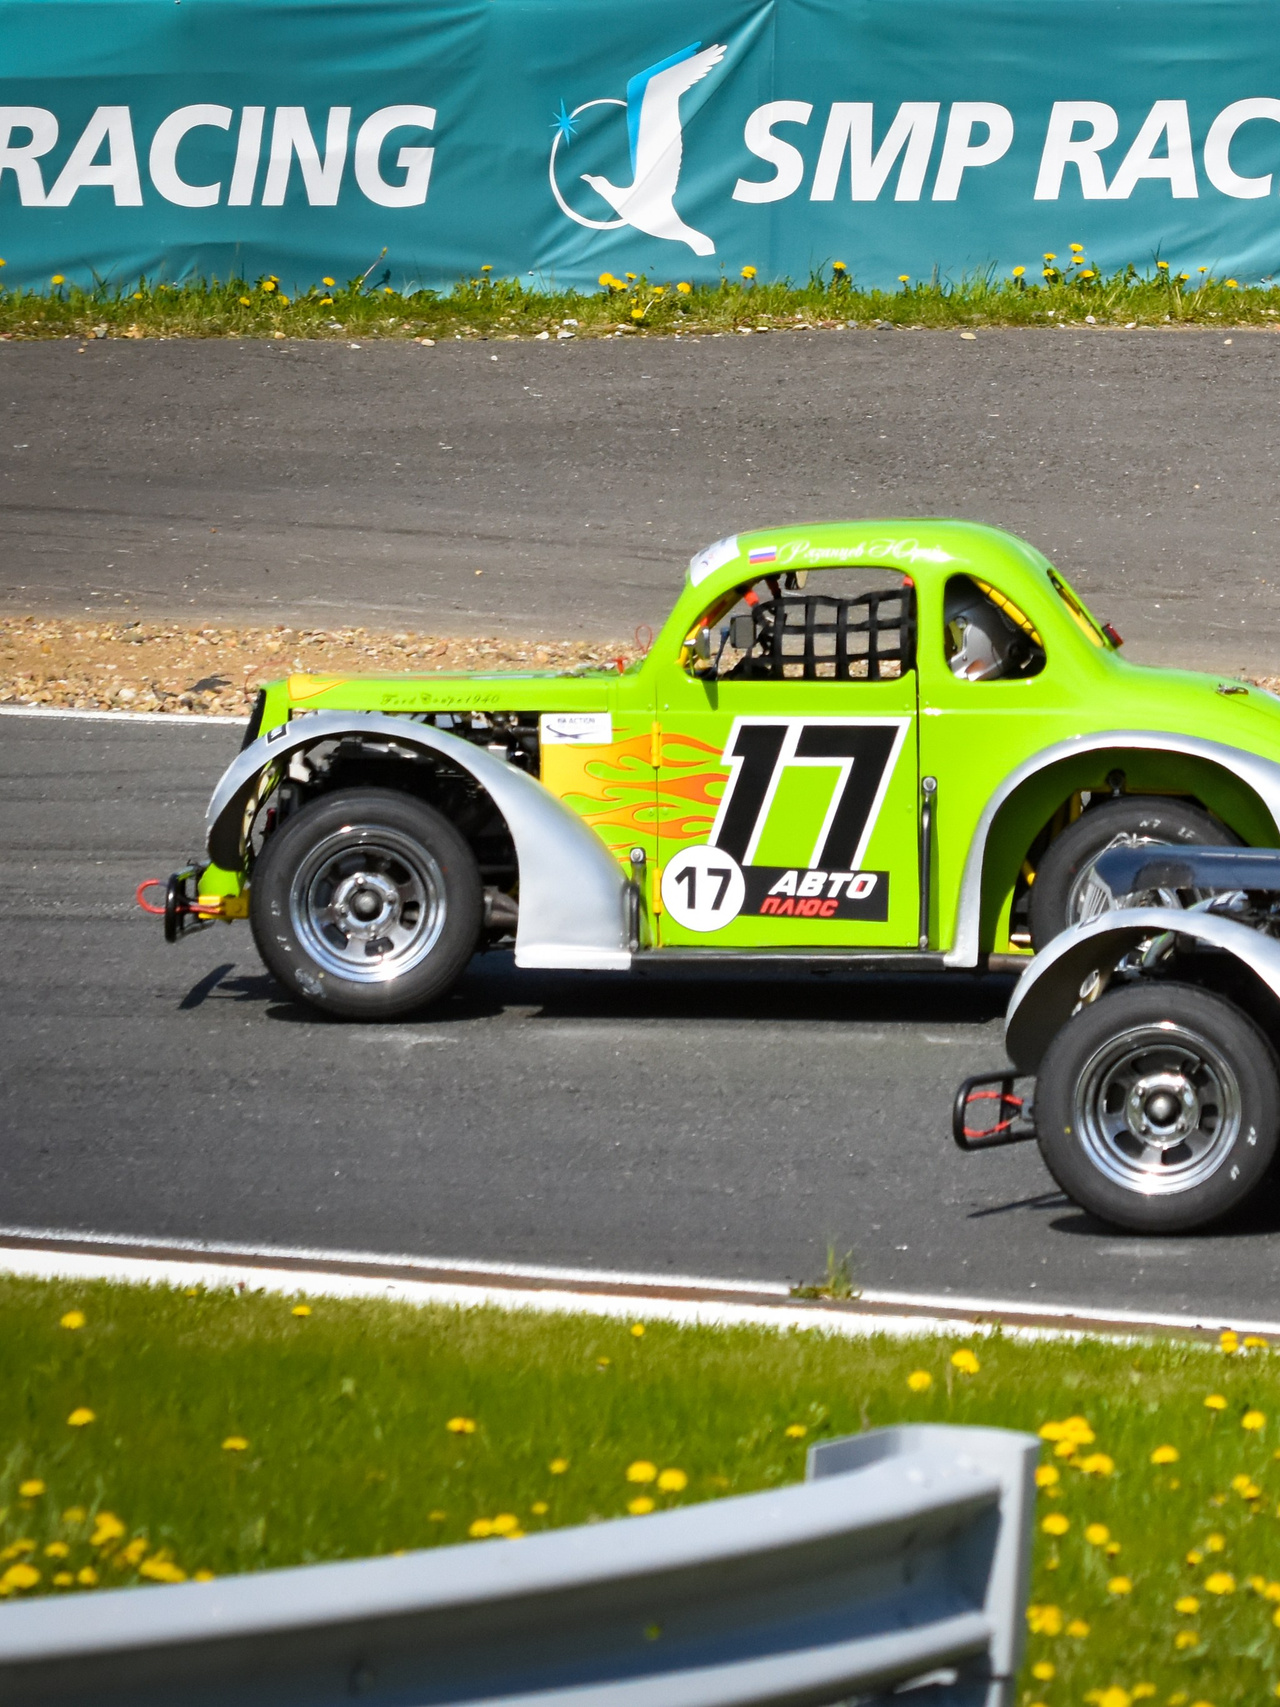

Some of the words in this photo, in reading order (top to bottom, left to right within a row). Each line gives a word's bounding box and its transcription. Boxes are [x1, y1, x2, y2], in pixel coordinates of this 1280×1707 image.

[0, 104, 436, 207] RACING
[732, 100, 1013, 204] SMP
[707, 716, 911, 870] 17
[675, 866, 732, 910] 17
[760, 897, 839, 917] ПЛЮС
[768, 870, 877, 899] АВТО
